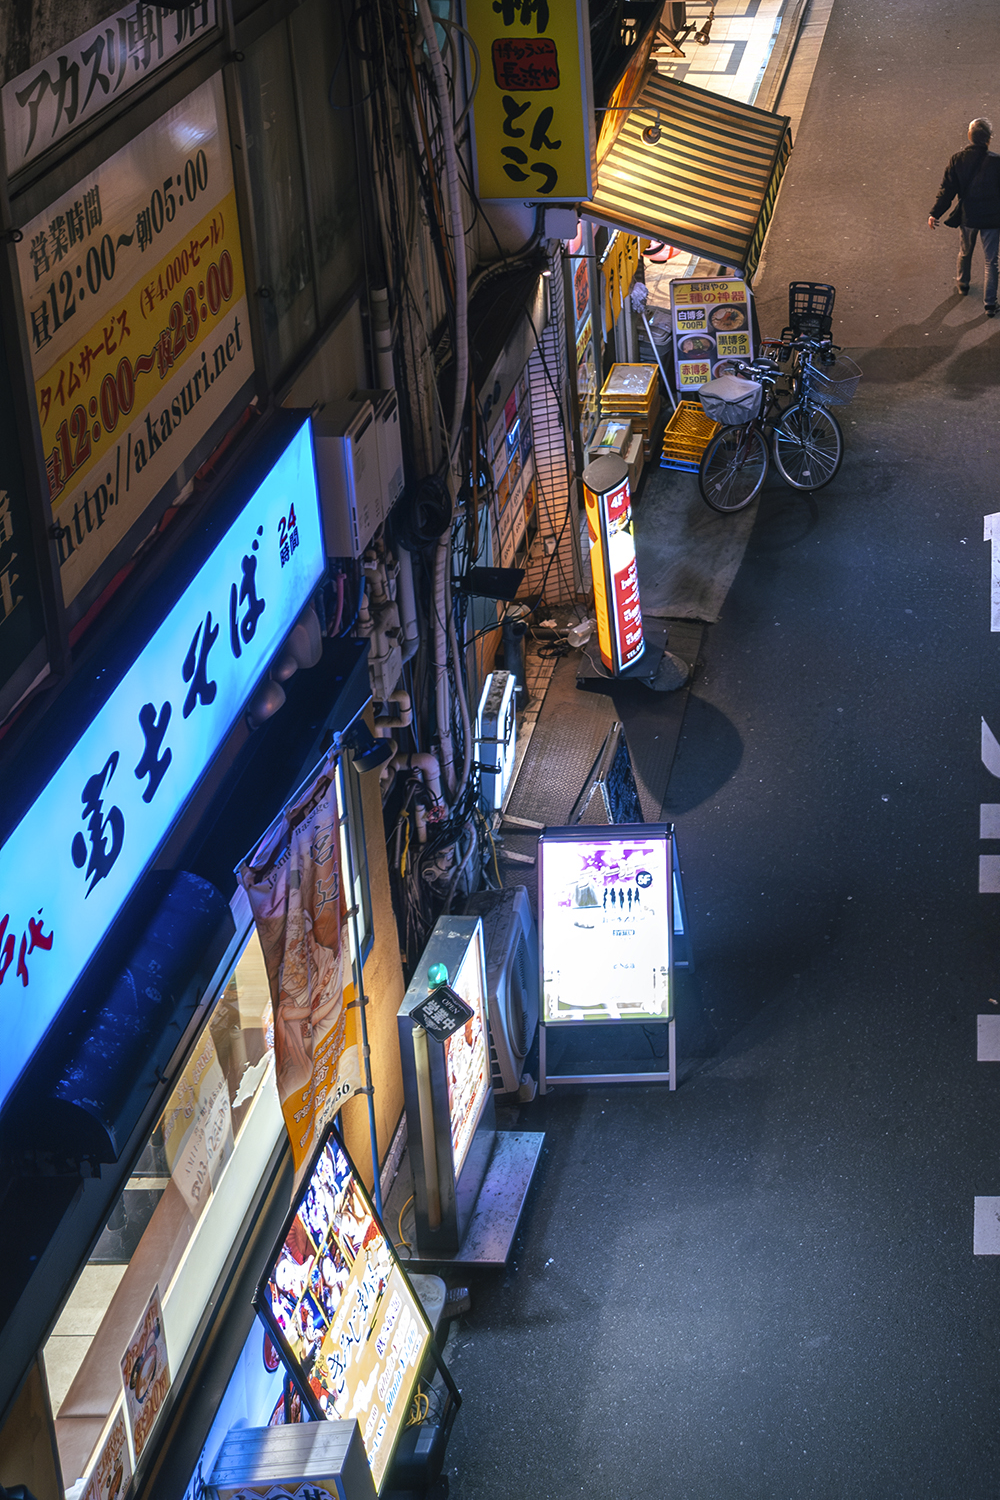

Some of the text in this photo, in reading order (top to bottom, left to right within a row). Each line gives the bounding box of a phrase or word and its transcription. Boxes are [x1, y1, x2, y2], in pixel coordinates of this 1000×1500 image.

[501, 95, 562, 194] とんこつ
[29, 184, 103, 283] 営業時間
[690, 283, 729, 292] 長浜やの
[675, 291, 745, 304] 三種の神器
[678, 309, 706, 320] 白博多
[681, 320, 704, 330] 700円
[718, 334, 748, 346] 黒博多
[722, 345, 747, 355] 750円
[39, 309, 131, 428] タイムサービス
[681, 364, 710, 376] 赤博多
[683, 375, 708, 384] 750円
[51, 316, 243, 568] http://akasuri.net
[610, 492, 624, 509] 4F
[277, 502, 297, 549] 24
[279, 526, 300, 569] 時間
[71, 524, 267, 901] 富士そば
[421, 999, 456, 1032] 営業中
[441, 997, 461, 1016] OPEN
